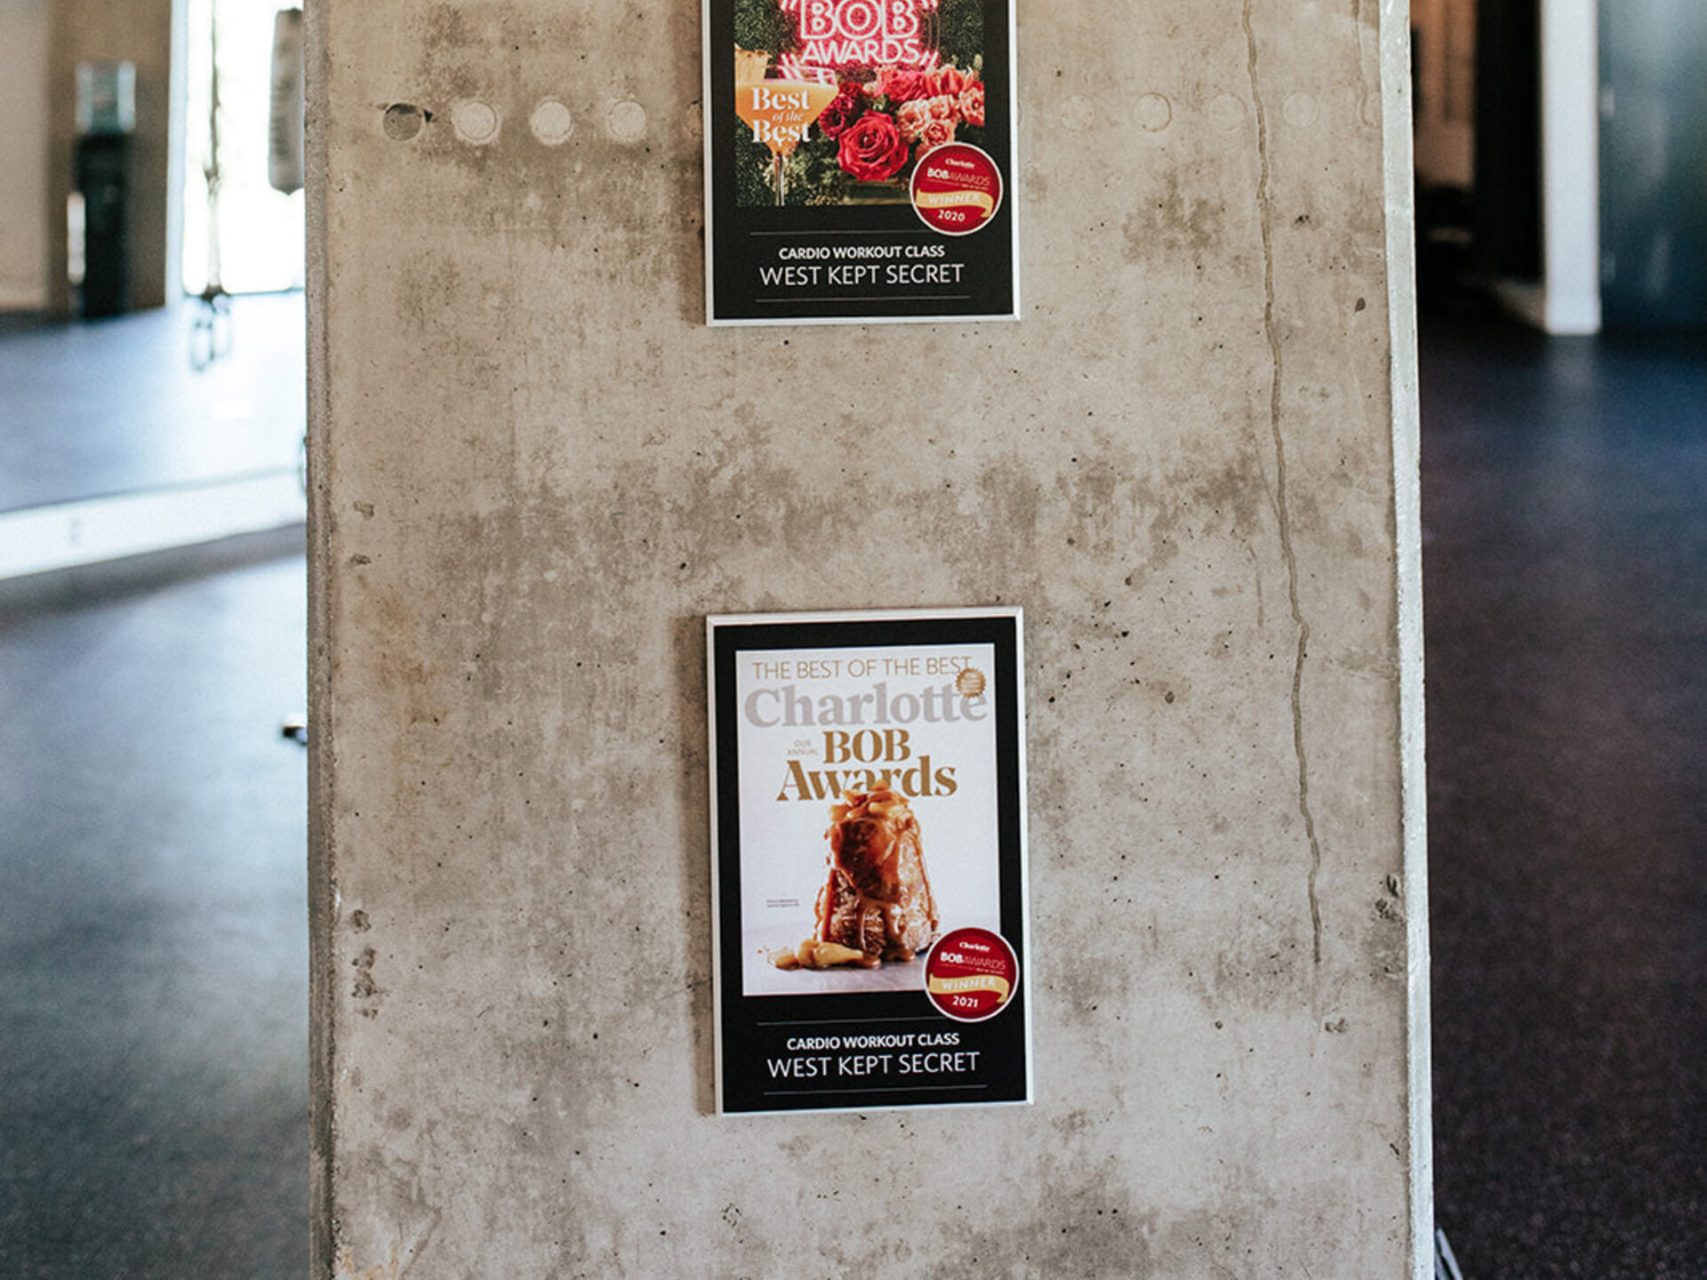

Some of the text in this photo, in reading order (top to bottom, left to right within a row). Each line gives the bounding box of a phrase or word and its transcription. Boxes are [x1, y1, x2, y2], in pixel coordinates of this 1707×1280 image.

[800, 39, 921, 64] AWARDS
[752, 87, 810, 110] Best
[752, 119, 811, 143] Best
[938, 209, 966, 222] 2020
[779, 245, 945, 260] CARDIO WORKOUT CLASS
[759, 264, 965, 285] WEST KEPT SECRET
[753, 656, 973, 680] THE BEST OF THE BEST
[744, 683, 988, 728] Charlotte
[823, 728, 911, 764] BOB
[777, 755, 958, 801] Awards
[942, 977, 996, 990] WINNER
[952, 995, 979, 1008] 2021
[787, 1033, 960, 1051] CARDIO WORKOUT CLASS
[767, 1052, 981, 1078] WEST KEPT SECRET
